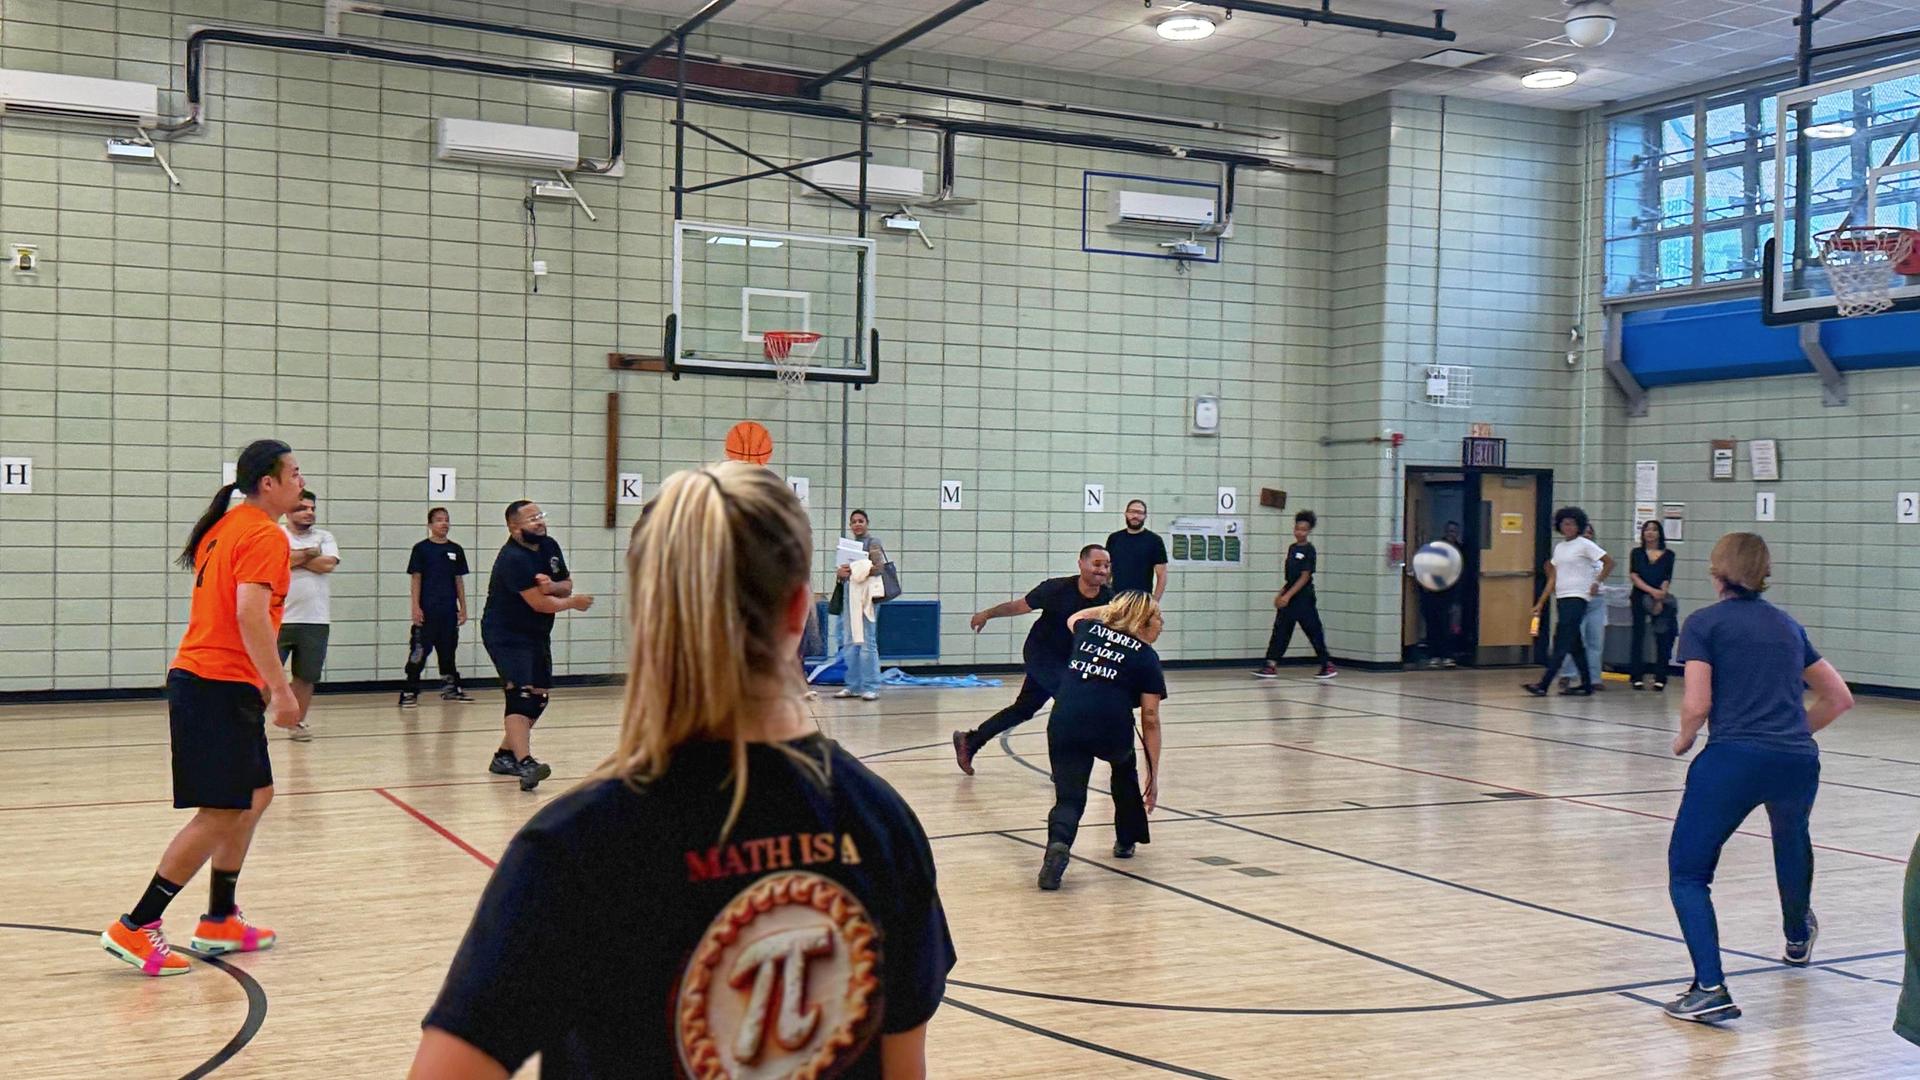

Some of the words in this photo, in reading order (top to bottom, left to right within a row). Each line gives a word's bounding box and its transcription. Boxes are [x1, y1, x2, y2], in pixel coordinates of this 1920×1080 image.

[4, 463, 30, 485] H
[436, 473, 448, 494] J
[621, 479, 640, 498] K
[943, 485, 960, 503] M
[1087, 489, 1102, 506] N
[1220, 492, 1234, 510] O
[1762, 497, 1769, 515] 1
[1903, 497, 1913, 516] 2
[1089, 624, 1142, 651] EXPLORER
[1080, 641, 1125, 663] LEADER
[1068, 659, 1118, 680] SCHOLAR
[684, 835, 793, 882] MATH
[797, 833, 835, 865] IS
[840, 832, 862, 865] A
